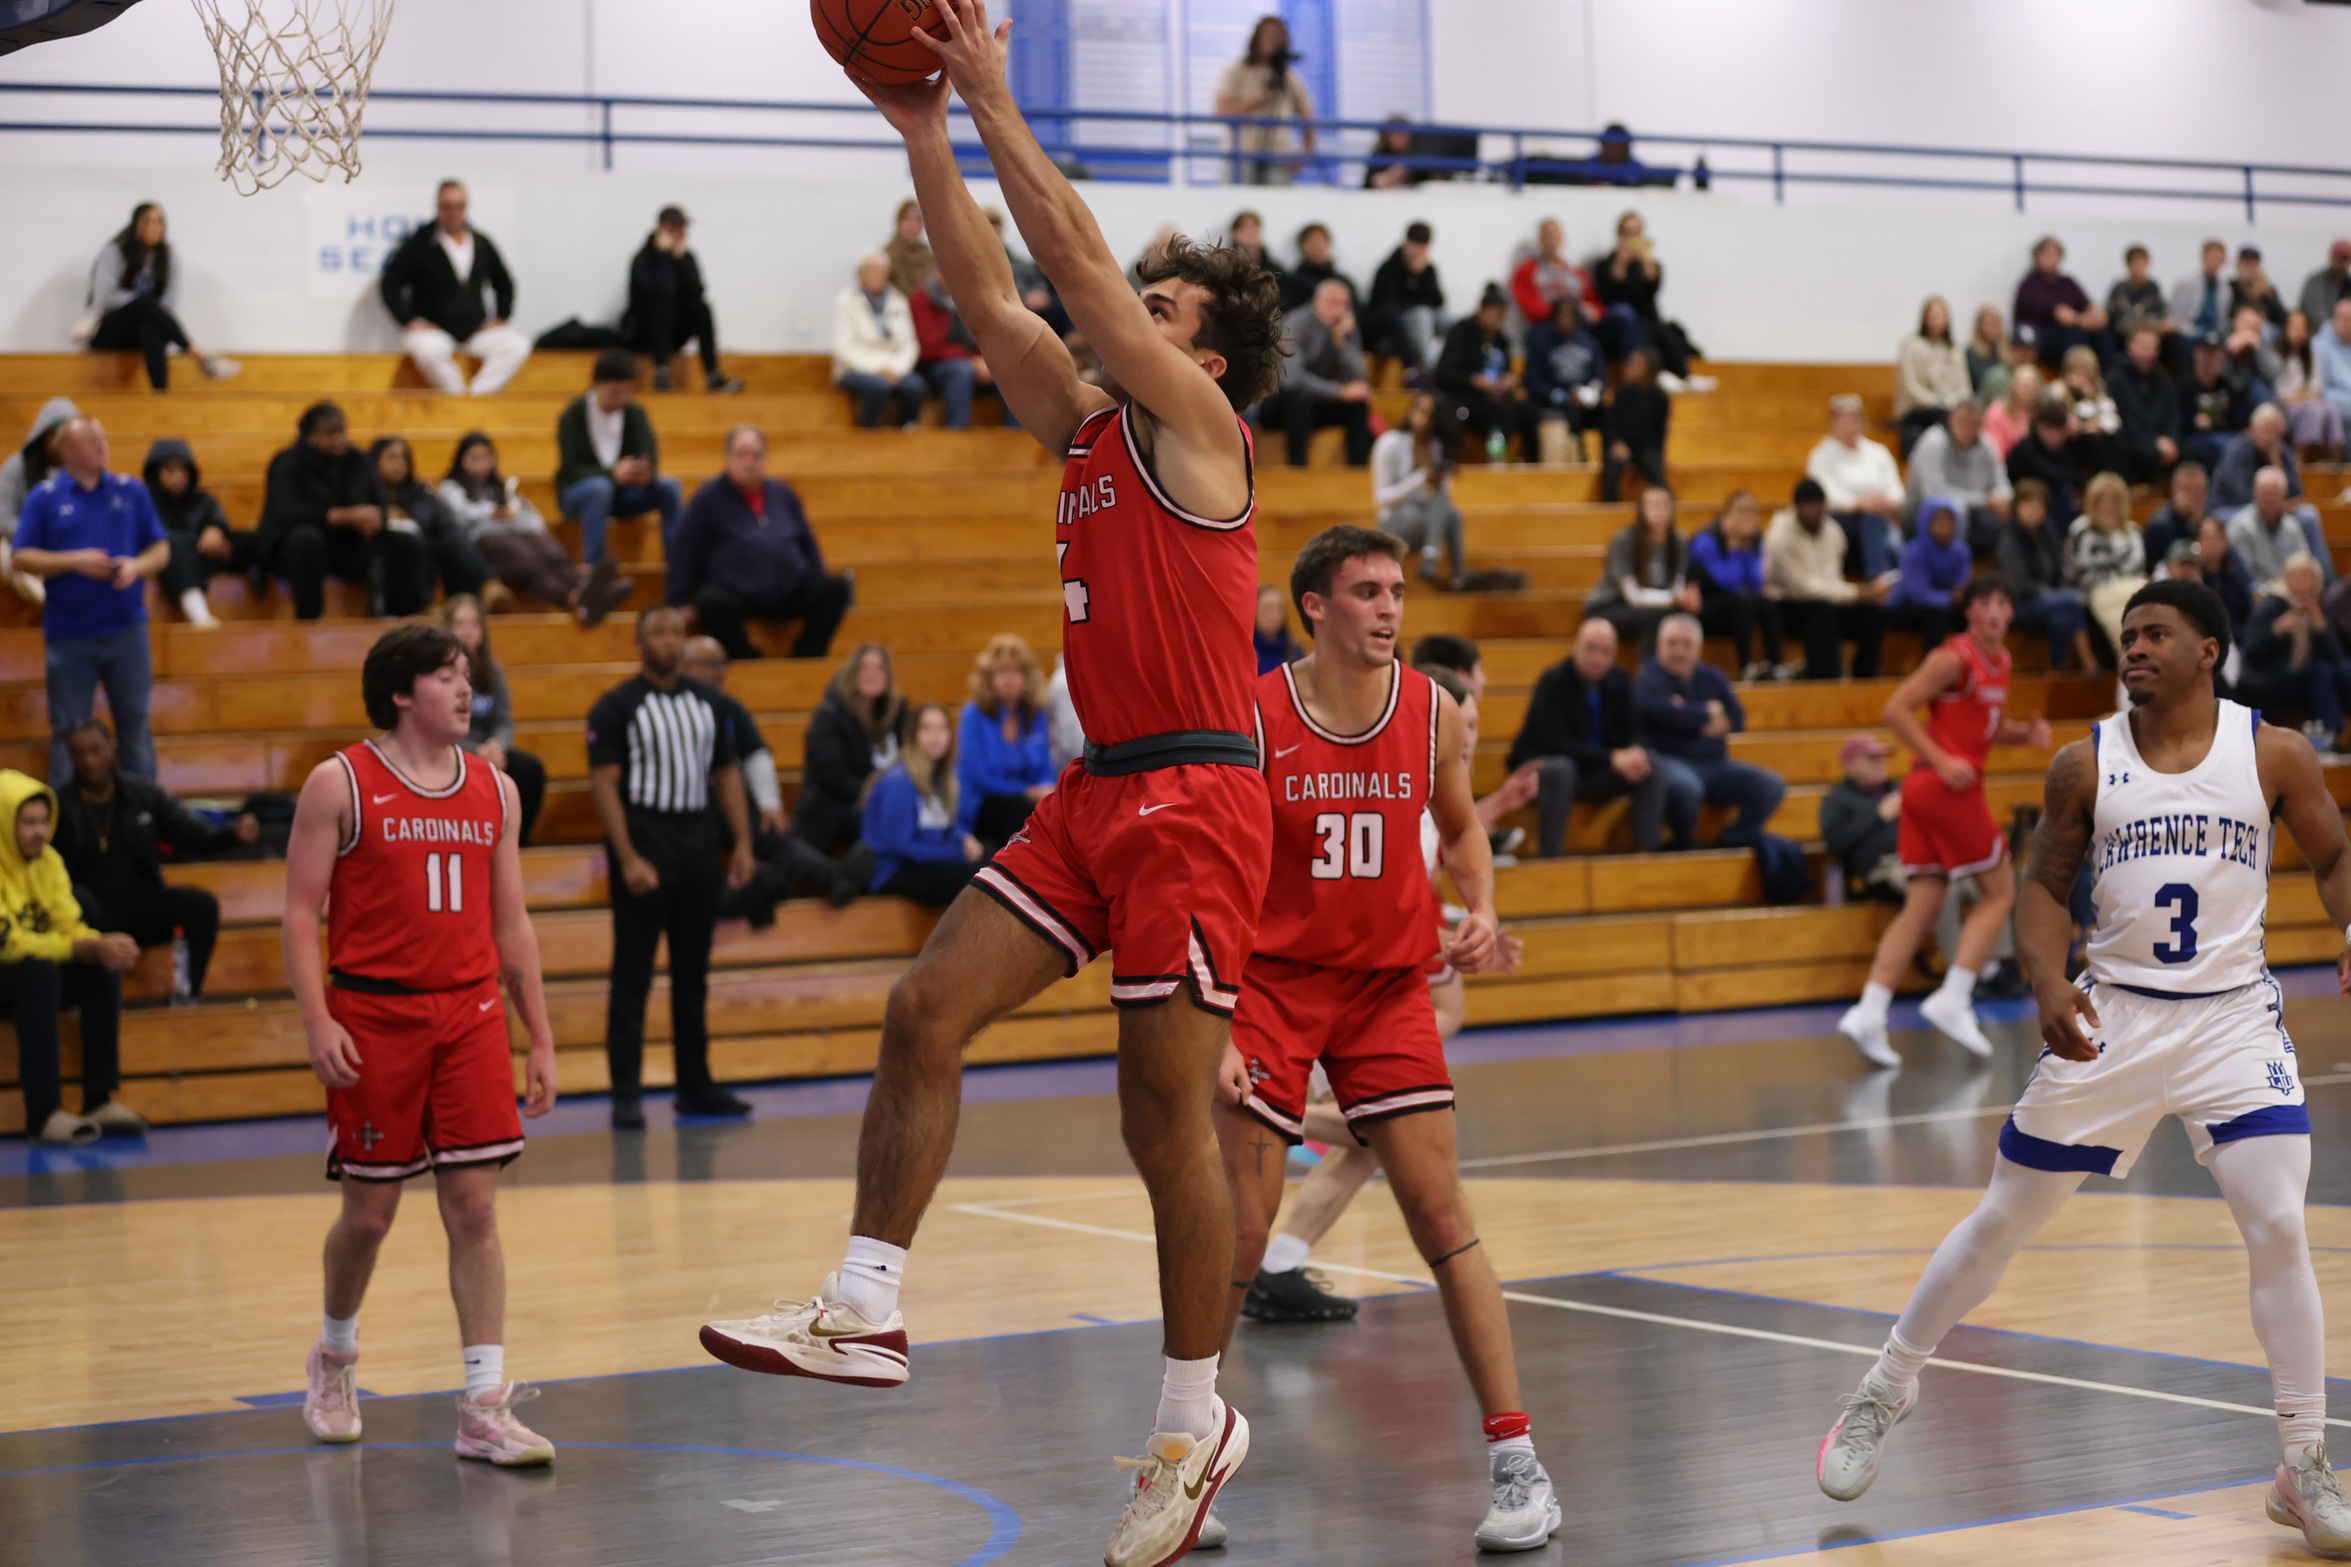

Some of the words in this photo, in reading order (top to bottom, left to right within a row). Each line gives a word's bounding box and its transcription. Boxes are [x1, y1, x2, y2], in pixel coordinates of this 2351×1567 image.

[1057, 473, 1117, 526] INALS
[1285, 771, 1412, 802] CARDINALS
[382, 816, 494, 847] CARDINALS
[1311, 812, 1384, 880] 30
[2218, 816, 2260, 870] TECH
[425, 851, 463, 913] 11
[2153, 883, 2199, 964] 3
